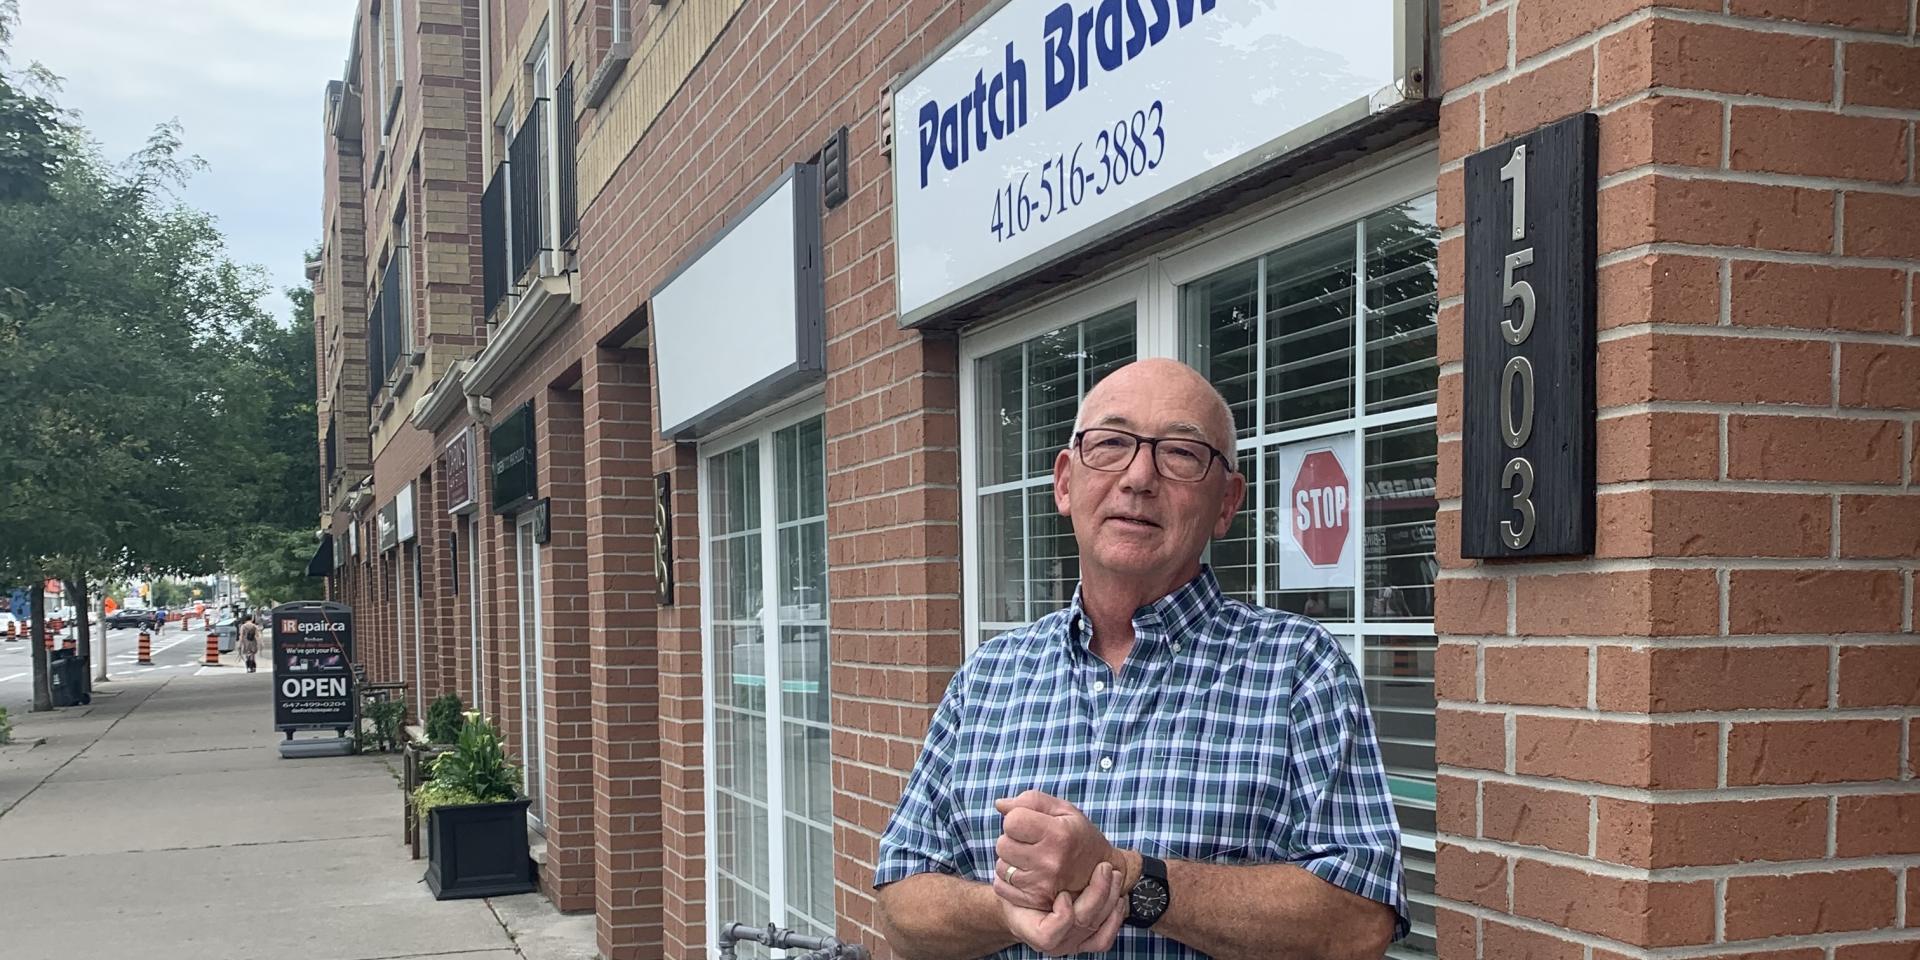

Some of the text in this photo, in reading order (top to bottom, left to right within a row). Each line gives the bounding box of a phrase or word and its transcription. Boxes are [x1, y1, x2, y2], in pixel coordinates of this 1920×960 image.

[918, 41, 1027, 190] Partch
[990, 99, 1165, 242] 416-516-3883
[1500, 144, 1536, 550] 1503
[1296, 486, 1347, 531] STOP
[283, 620, 345, 634] iRepair.ca
[282, 678, 346, 698] OPEN
